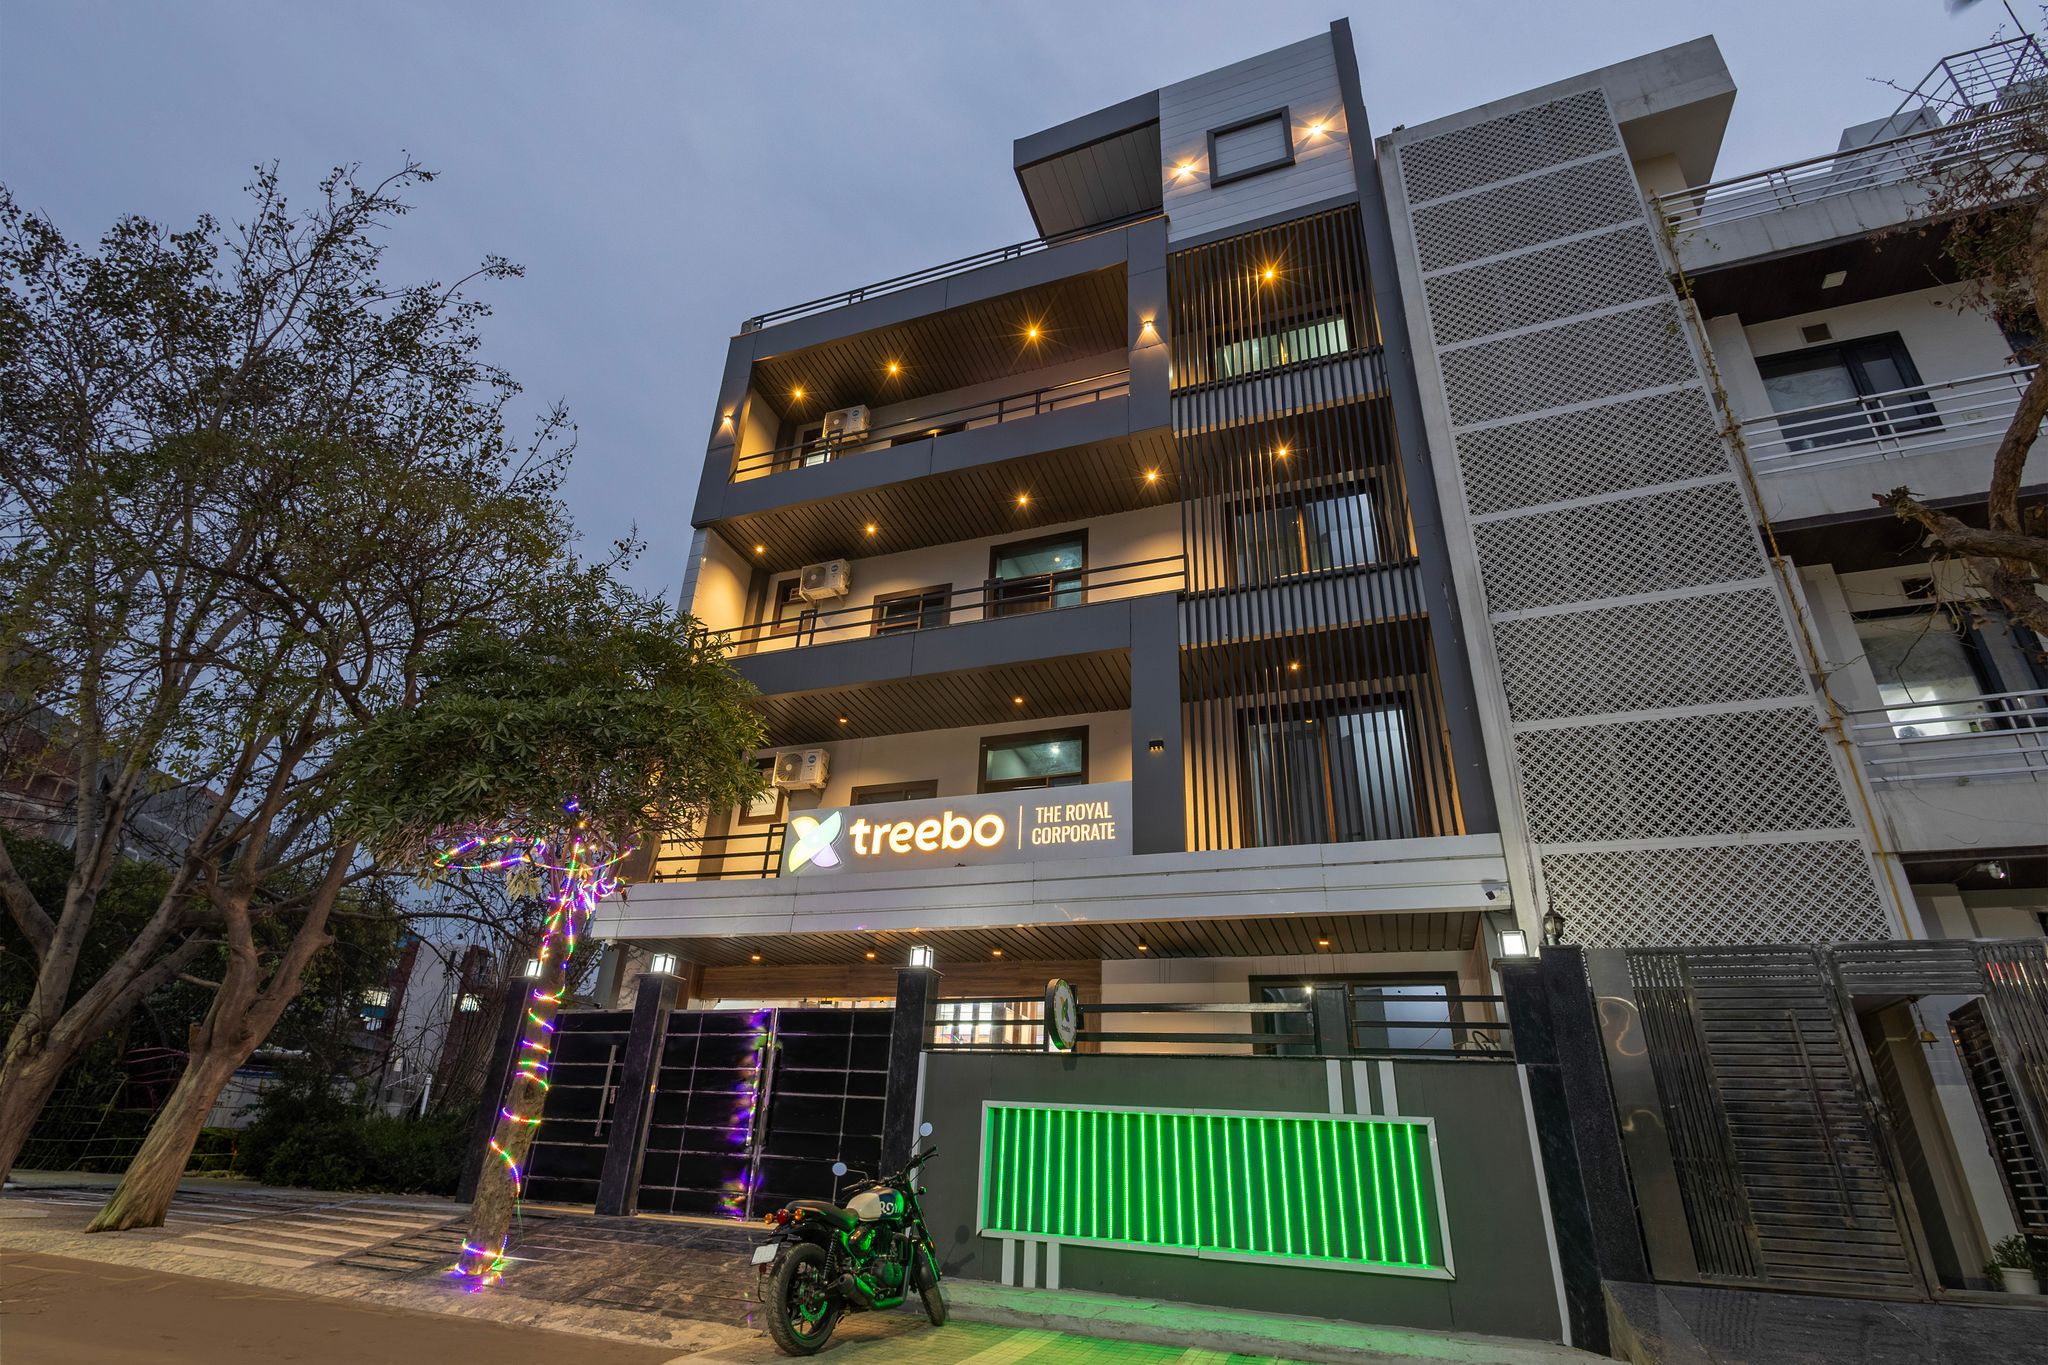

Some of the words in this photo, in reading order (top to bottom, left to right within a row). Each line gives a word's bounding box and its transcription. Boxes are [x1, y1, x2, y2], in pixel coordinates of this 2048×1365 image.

[1035, 805, 1062, 823] THE
[1065, 801, 1112, 821] ROYAL
[849, 811, 1004, 855] treebo
[1032, 821, 1115, 845] CORPORATE
